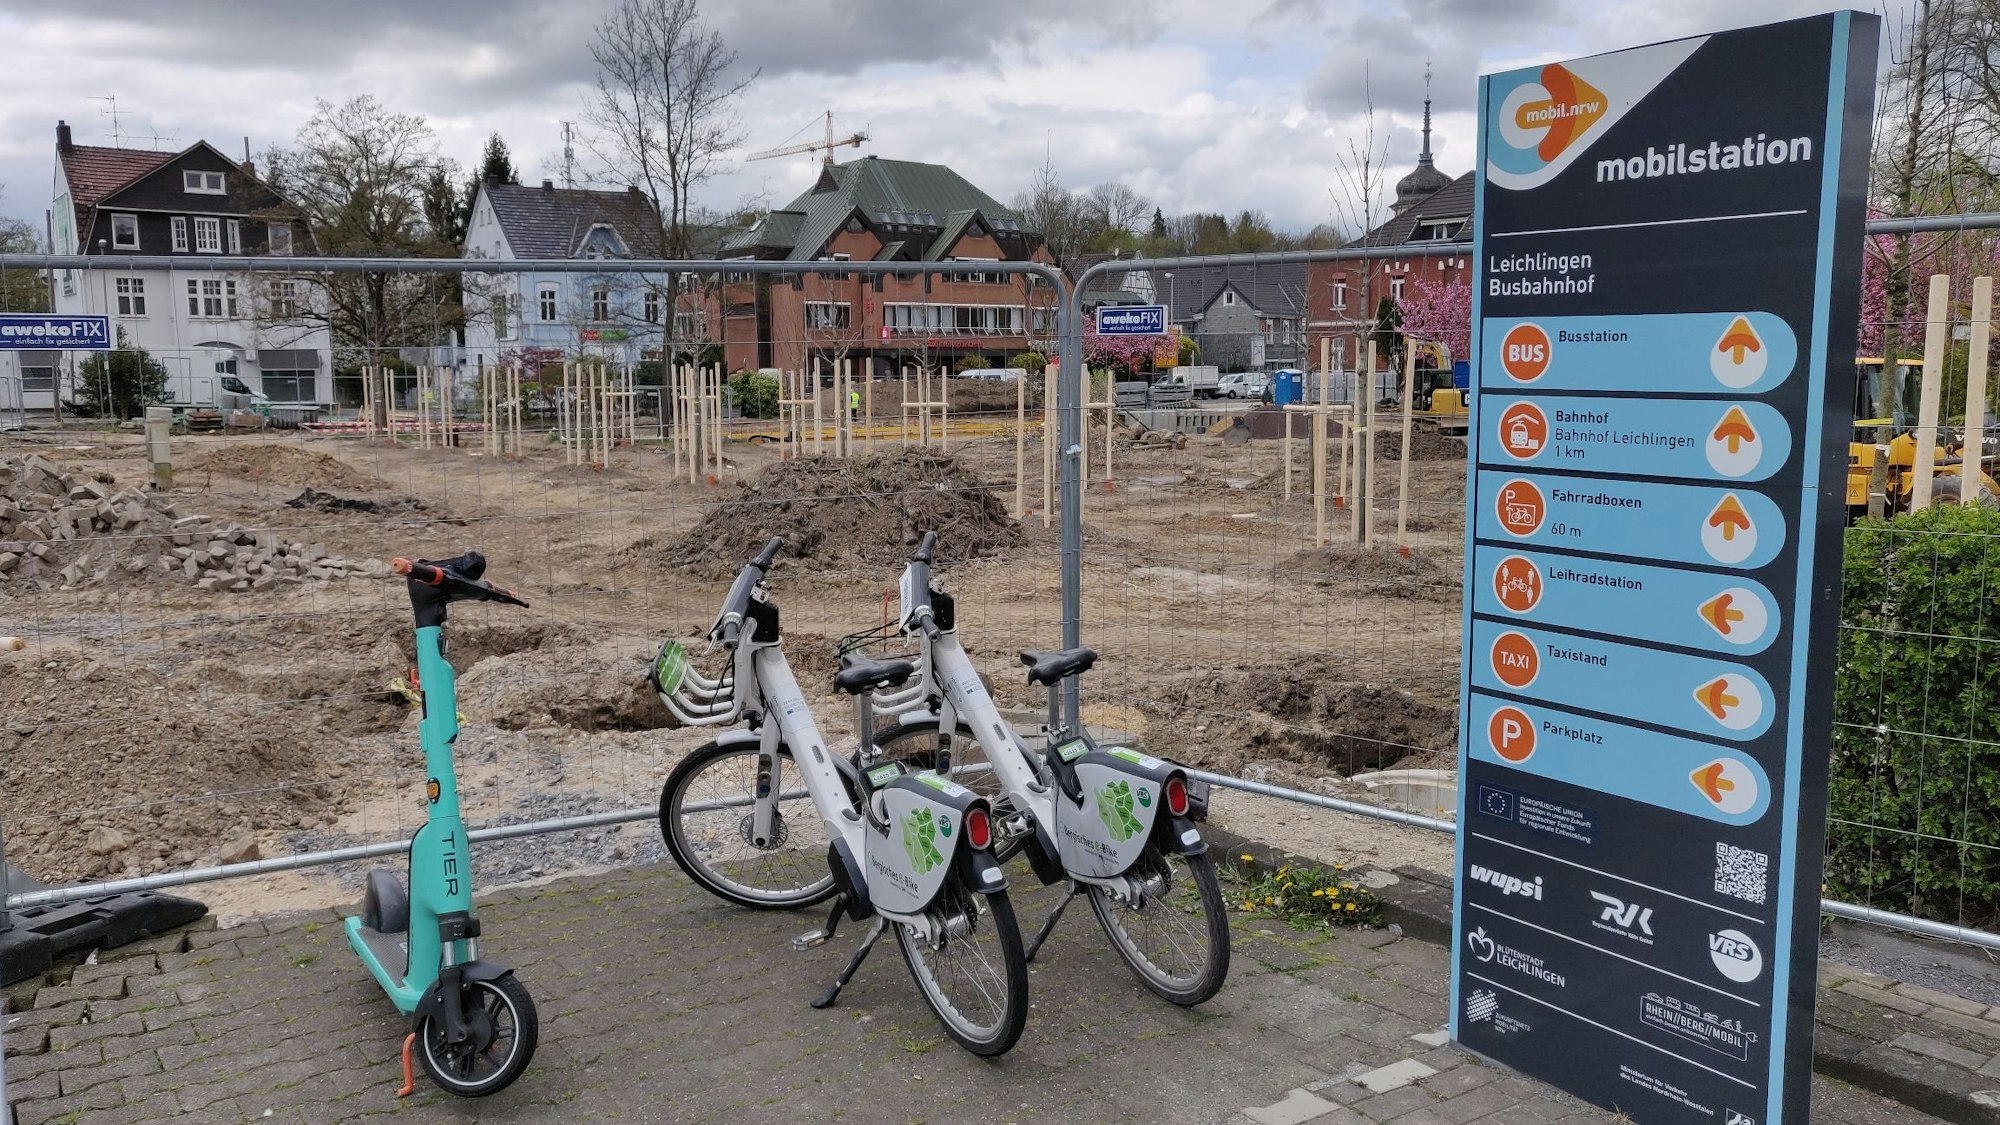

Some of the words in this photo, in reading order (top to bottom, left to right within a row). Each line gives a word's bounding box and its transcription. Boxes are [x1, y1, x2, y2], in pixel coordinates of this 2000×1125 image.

[1526, 101, 1599, 122] mobil.nrw
[1597, 133, 1812, 182] mobilstation
[1490, 252, 1592, 274] Leichlingen
[1489, 274, 1595, 296] Busbahnhof
[1103, 311, 1159, 325] awekoFIX
[1, 321, 103, 337] awekoFIX
[1559, 330, 1628, 343] Busstation
[15, 337, 43, 345] einfach
[45, 337, 54, 345] fix
[56, 338, 90, 346] gesichert
[1509, 344, 1544, 363] BUS
[1556, 410, 1608, 424] Bahnhof
[1555, 428, 1609, 443] Bahnhof
[1613, 431, 1694, 448] Leichlingen
[1955, 434, 1998, 444] VVO
[1555, 446, 1560, 457] 1
[1565, 445, 1585, 459] km
[1552, 489, 1642, 508] Fahrradboxen
[1551, 523, 1566, 536] 60
[1569, 527, 1581, 537] m
[1549, 567, 1643, 591] Leihradstation
[1501, 651, 1529, 669] TAXI
[1547, 645, 1608, 666] Taxistand
[1502, 718, 1522, 748] P
[1543, 721, 1603, 745] Parkplatz
[1520, 797, 1562, 814] EUROPÄISCHE
[1563, 809, 1584, 819] UNION
[1519, 811, 1556, 826] Europäischer
[1557, 821, 1576, 832] Fonds
[1570, 817, 1591, 829] Zukunft
[1555, 828, 1591, 845] Entwicklung
[442, 831, 458, 897] TIER
[1470, 864, 1543, 900] wupsi
[1496, 944, 1545, 968] BLÜTENSTADT
[1709, 933, 1750, 960] VRS
[1496, 953, 1565, 987] LEICHLINGEN
[1620, 1064, 1654, 1083] Ministerium
[1655, 1079, 1664, 1088] für
[1664, 1083, 1688, 1098] Verkehr
[1620, 1072, 1631, 1081] des
[1631, 1076, 1652, 1090] Landes
[1652, 1085, 1715, 1116] Nordrhein-Westfalen
